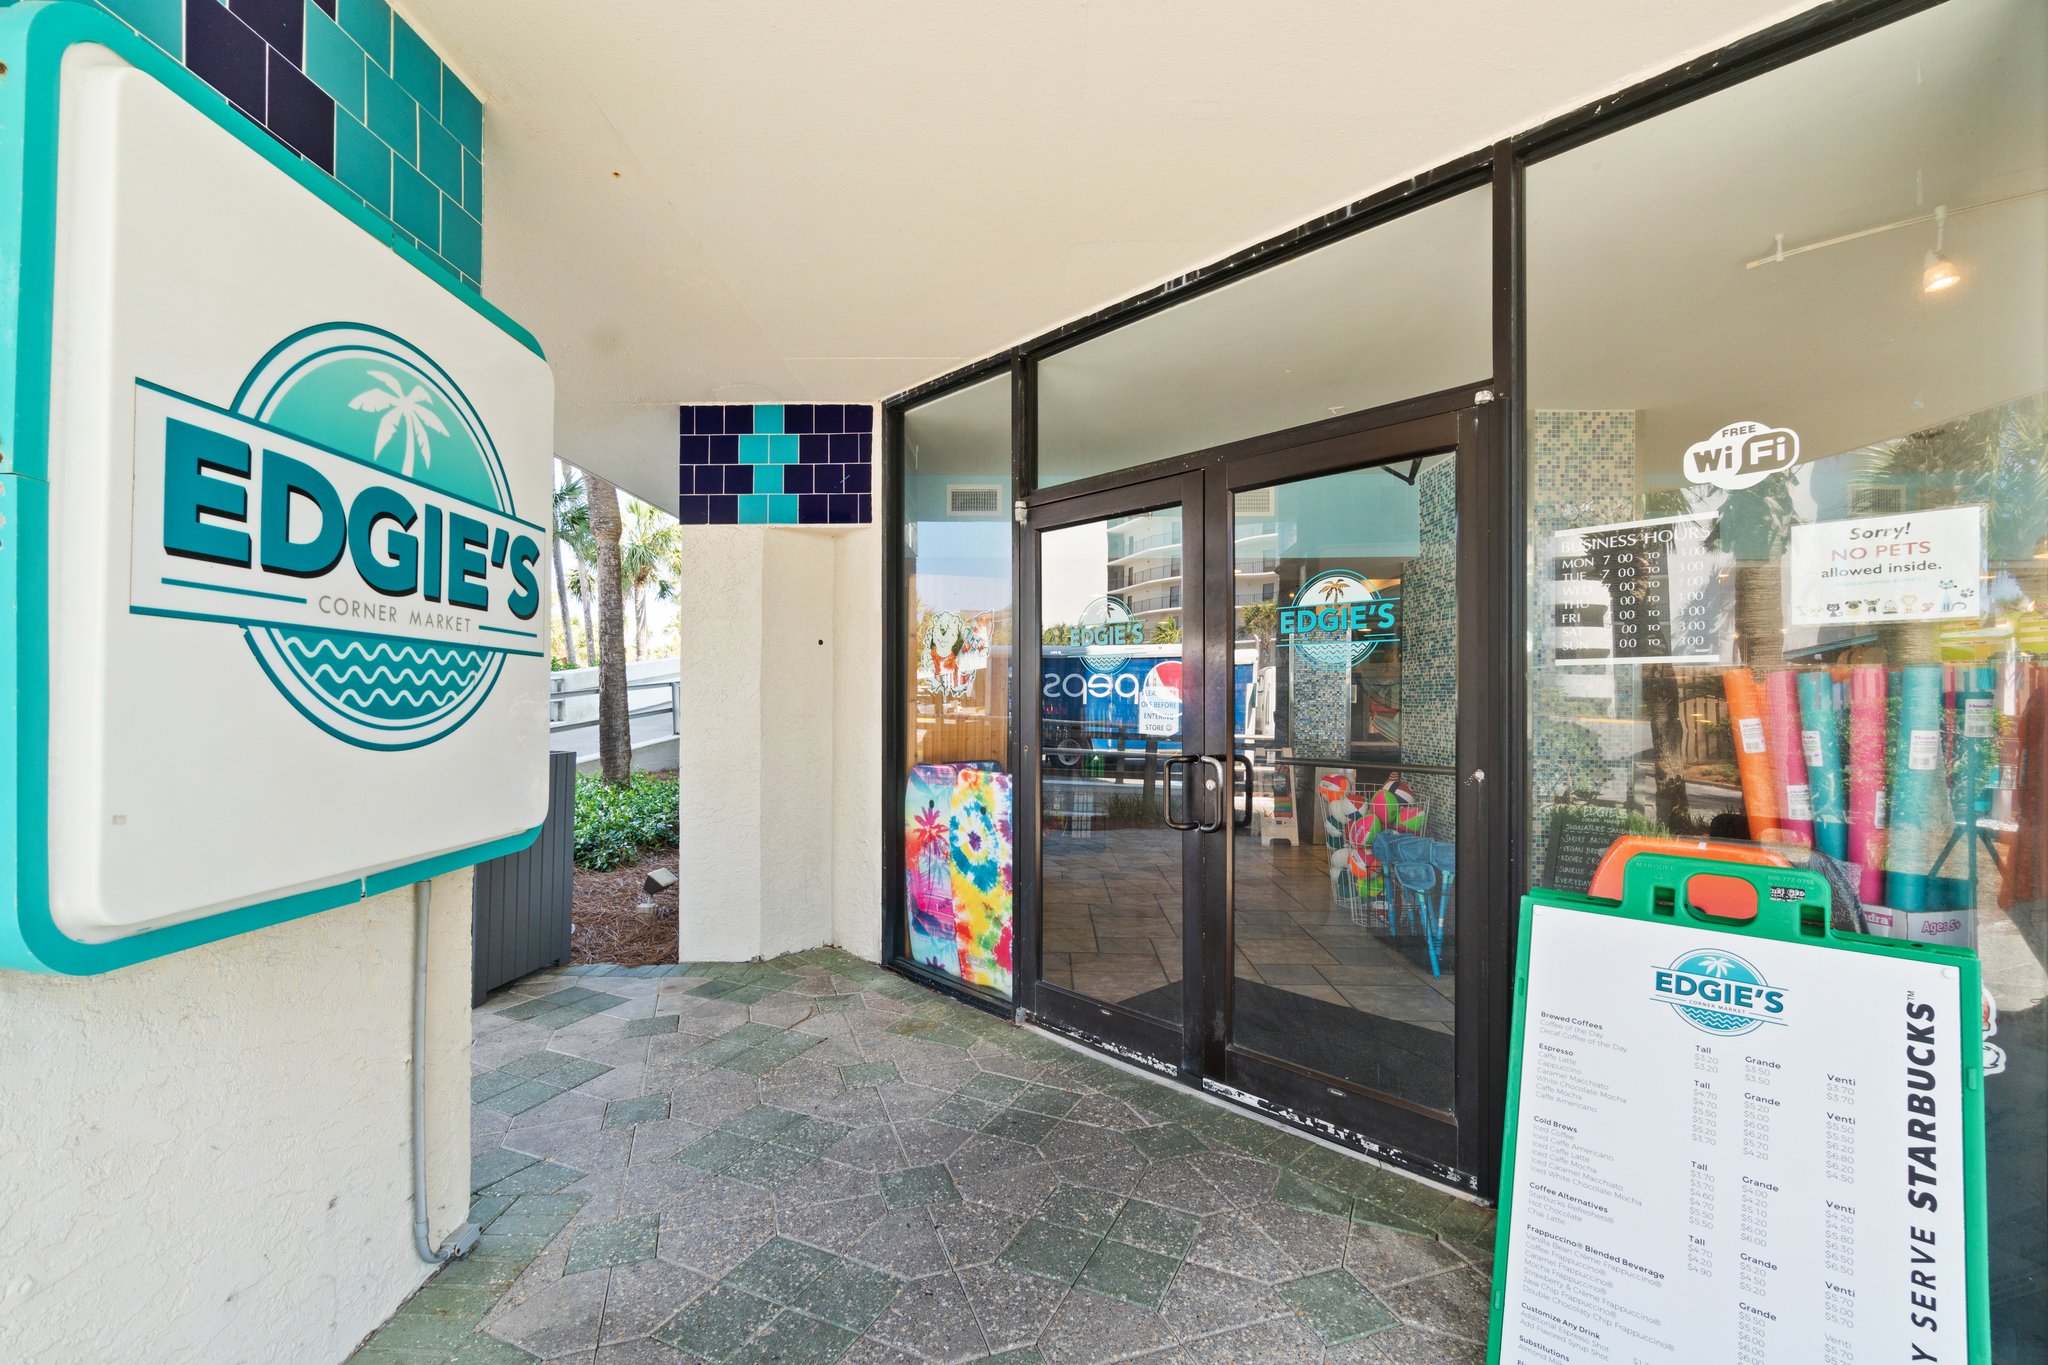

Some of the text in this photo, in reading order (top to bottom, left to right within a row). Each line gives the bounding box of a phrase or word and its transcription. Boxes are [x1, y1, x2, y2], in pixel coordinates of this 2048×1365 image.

[1722, 425, 1756, 438] FREE
[163, 416, 540, 621] EDGIE'S
[1850, 522, 1911, 540] Sorry!
[1562, 527, 1710, 553] BUSINESS HOURS
[1832, 541, 1931, 561] NO PETS
[1562, 557, 1594, 569] MON
[1603, 555, 1610, 565] 7
[1618, 553, 1633, 563] 00
[1602, 570, 1609, 579] 7
[1618, 568, 1635, 577] 00
[1821, 560, 1942, 578] allowed inside.
[1563, 586, 1592, 596] WED
[1620, 582, 1634, 591] 00
[1688, 576, 1703, 586] 00
[1621, 596, 1635, 605] 00
[1688, 591, 1703, 601] 00
[319, 595, 470, 632] CORNER MARKET
[1281, 603, 1395, 634] EDGIE'S
[1562, 614, 1580, 623] FRI
[1620, 610, 1635, 620] 00
[1689, 606, 1705, 616] 00
[1070, 623, 1144, 646] EDGIE'S
[1622, 624, 1636, 634] 00
[1689, 621, 1705, 631] 00
[1620, 639, 1636, 648] 00
[1687, 636, 1704, 646] 00
[1921, 920, 1961, 935] Ages 5+
[1656, 971, 1784, 1013] EDGIE'S
[1688, 999, 1745, 1014] CORNER MARKET
[1541, 1012, 1603, 1030] Brewed Coffees
[1540, 1019, 1563, 1029] Coffee
[1574, 1026, 1587, 1035] the
[1589, 1030, 1603, 1039] Day
[1539, 1043, 1573, 1056] Espresso
[1695, 1045, 1711, 1054] Tall
[1558, 1056, 1577, 1065] Latte
[1695, 1053, 1718, 1064] $3.20
[1745, 1056, 1782, 1069] Grande
[1537, 1059, 1582, 1075] Cappuccino
[1694, 1062, 1718, 1073] $3.20
[1745, 1065, 1770, 1076] $3.50
[1537, 1067, 1609, 1090] Caramel Macchiato
[1694, 1080, 1710, 1089] Tall
[1745, 1074, 1770, 1085] $3.50
[1827, 1074, 1856, 1086] Venti
[1536, 1075, 1627, 1104] White Chocolate Mocha
[1557, 1088, 1582, 1100] Mocha
[1693, 1089, 1718, 1100] $4.70
[1827, 1083, 1854, 1095] $3.70
[1556, 1097, 1597, 1113] Americano
[1744, 1092, 1781, 1106] Grande
[1827, 1092, 1854, 1105] $3.70
[1693, 1107, 1717, 1118] $5.50
[1744, 1101, 1770, 1113] $5.20
[1534, 1116, 1578, 1133] Cold Brews
[1744, 1120, 1769, 1132] $6.00
[1827, 1112, 1856, 1125] Venti
[1692, 1124, 1716, 1137] $5.20
[1826, 1121, 1854, 1134] $5.50
[1743, 1138, 1769, 1151] $5.70
[1826, 1141, 1854, 1154] $6.20
[1826, 1150, 1854, 1164] $6.80
[1691, 1161, 1708, 1171] Tall
[1531, 1157, 1623, 1191] Iced Caramel Macchiato
[1826, 1170, 1854, 1183] $4.50
[1742, 1176, 1779, 1192] Grande
[1529, 1182, 1608, 1213] Coffee Alternatives
[1529, 1190, 1565, 1208] Starbucks
[1690, 1188, 1715, 1201] $4.60
[1528, 1199, 1582, 1222] Hot Chocolate
[1826, 1200, 1856, 1215] Venti
[1528, 1208, 1565, 1225] Chai Latte
[1825, 1210, 1854, 1224] $4.20
[1688, 1235, 1705, 1246] Tall
[1825, 1230, 1854, 1245] $5.80
[1825, 1240, 1854, 1255] $6.30
[1585, 1245, 1620, 1263] Blended
[1622, 1259, 1665, 1280] Beverage
[1740, 1252, 1778, 1270] Grande
[1523, 1268, 1563, 1289] Strawberry
[1740, 1272, 1766, 1286] $4.50
[1911, 1226, 1937, 1332] SERVE
[1825, 1281, 1856, 1297] Venti
[1739, 1302, 1777, 1321] Grande
[1825, 1302, 1854, 1318] $5.00
[1521, 1302, 1600, 1340] Customize Any Drink
[1520, 1310, 1609, 1353] Additional Espresso Shot
[1824, 1332, 1852, 1349] Venti
[1519, 1335, 1570, 1362] Substitutions
